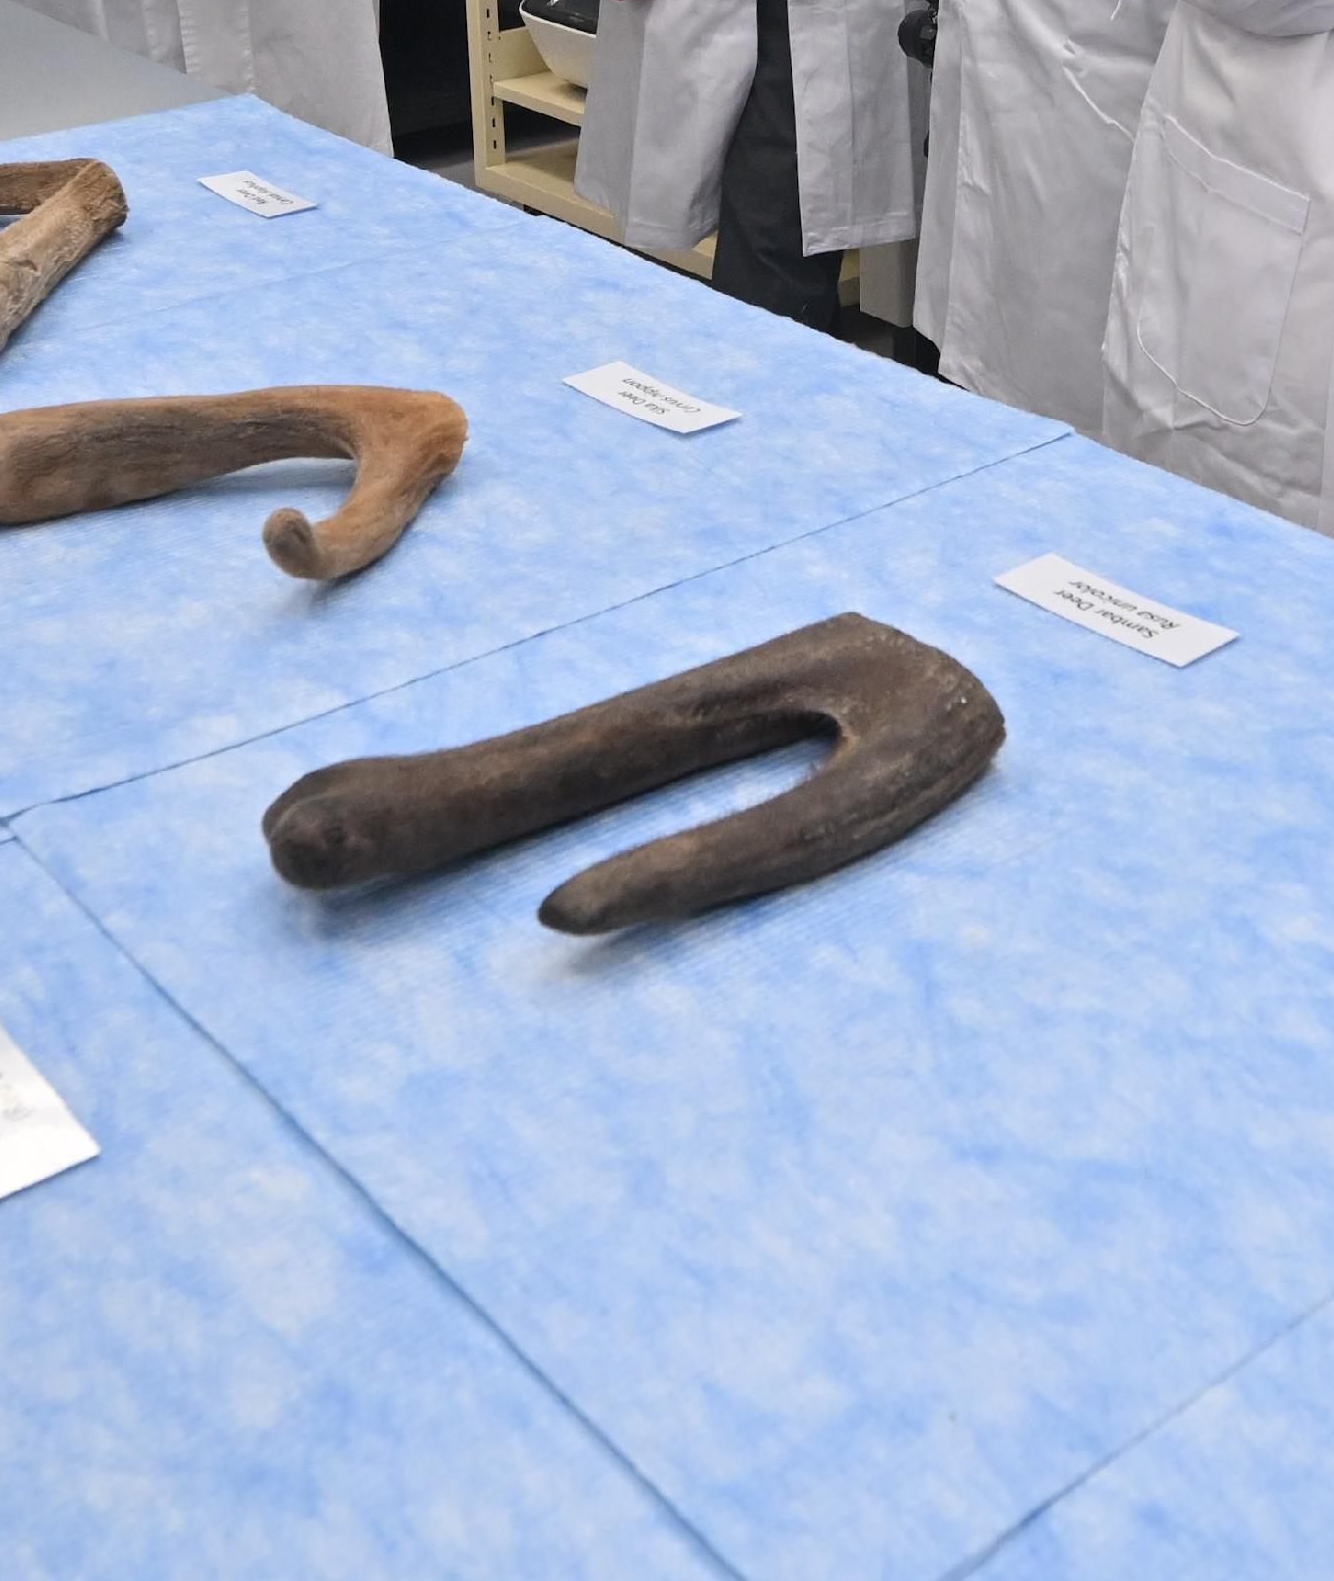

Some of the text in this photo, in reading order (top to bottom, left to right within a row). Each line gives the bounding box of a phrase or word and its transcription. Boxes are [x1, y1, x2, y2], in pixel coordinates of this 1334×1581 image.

[618, 391, 646, 404] Deer
[622, 378, 664, 398] nippon
[1053, 589, 1159, 639] Sambar Deer
[1069, 580, 1181, 631] Rusa unicolor
